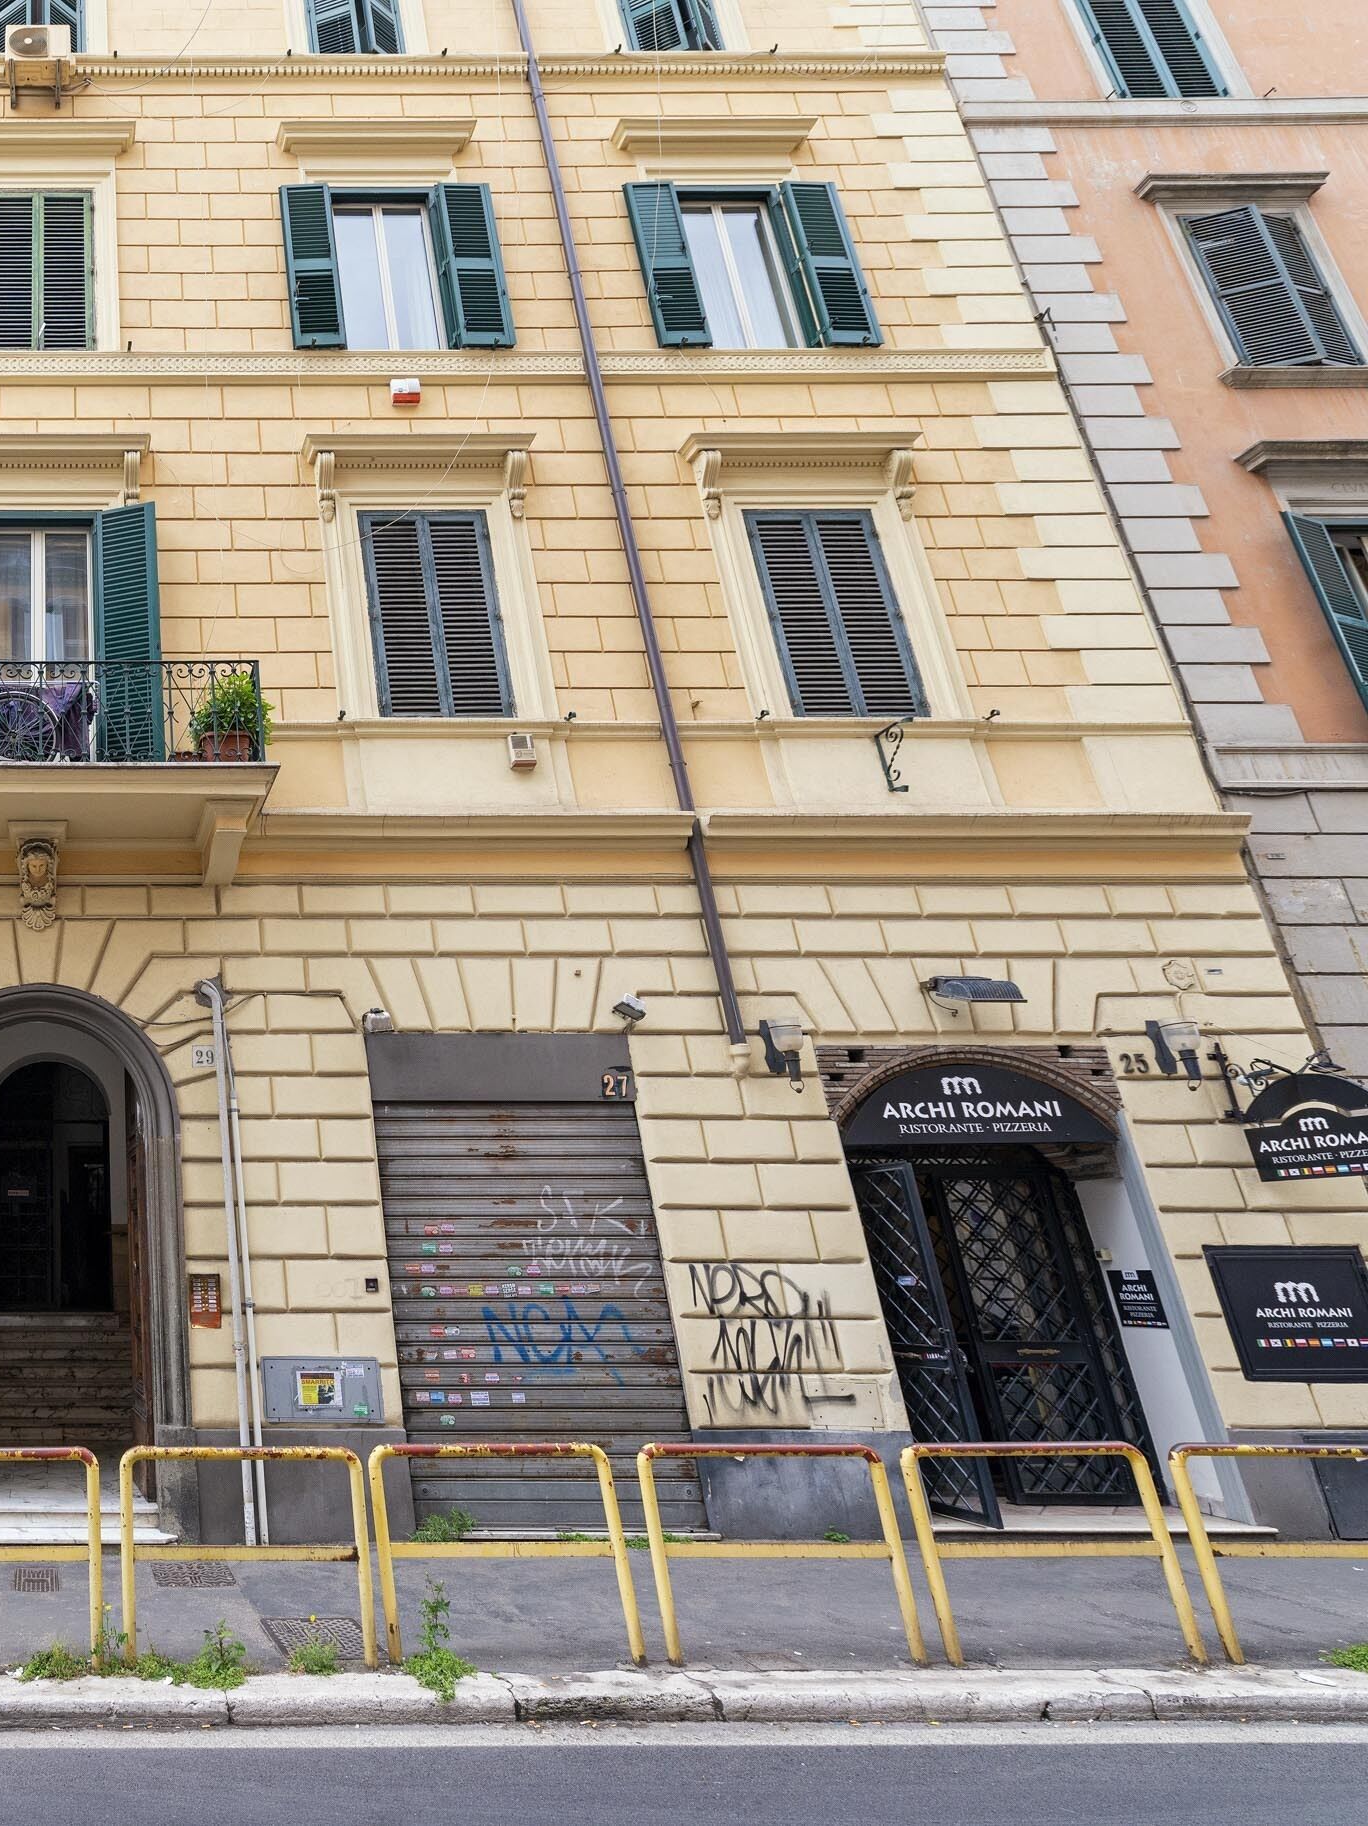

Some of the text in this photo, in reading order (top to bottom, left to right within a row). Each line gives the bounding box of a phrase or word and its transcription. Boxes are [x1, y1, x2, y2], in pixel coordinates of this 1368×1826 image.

[195, 1050, 214, 1064] 29
[1119, 1053, 1149, 1074] 25
[602, 1074, 628, 1097] 27
[882, 1100, 1063, 1119] ARCHI ROMANI
[899, 1122, 1052, 1134] RISTORANTE PIZZERIA
[1259, 1136, 1311, 1153] ARCHI
[1272, 1152, 1333, 1164] RISTORANTE
[1121, 1284, 1148, 1292] ARCHI
[1119, 1292, 1154, 1300] ROMANI
[1256, 1307, 1353, 1318] ARCHI ROMANI
